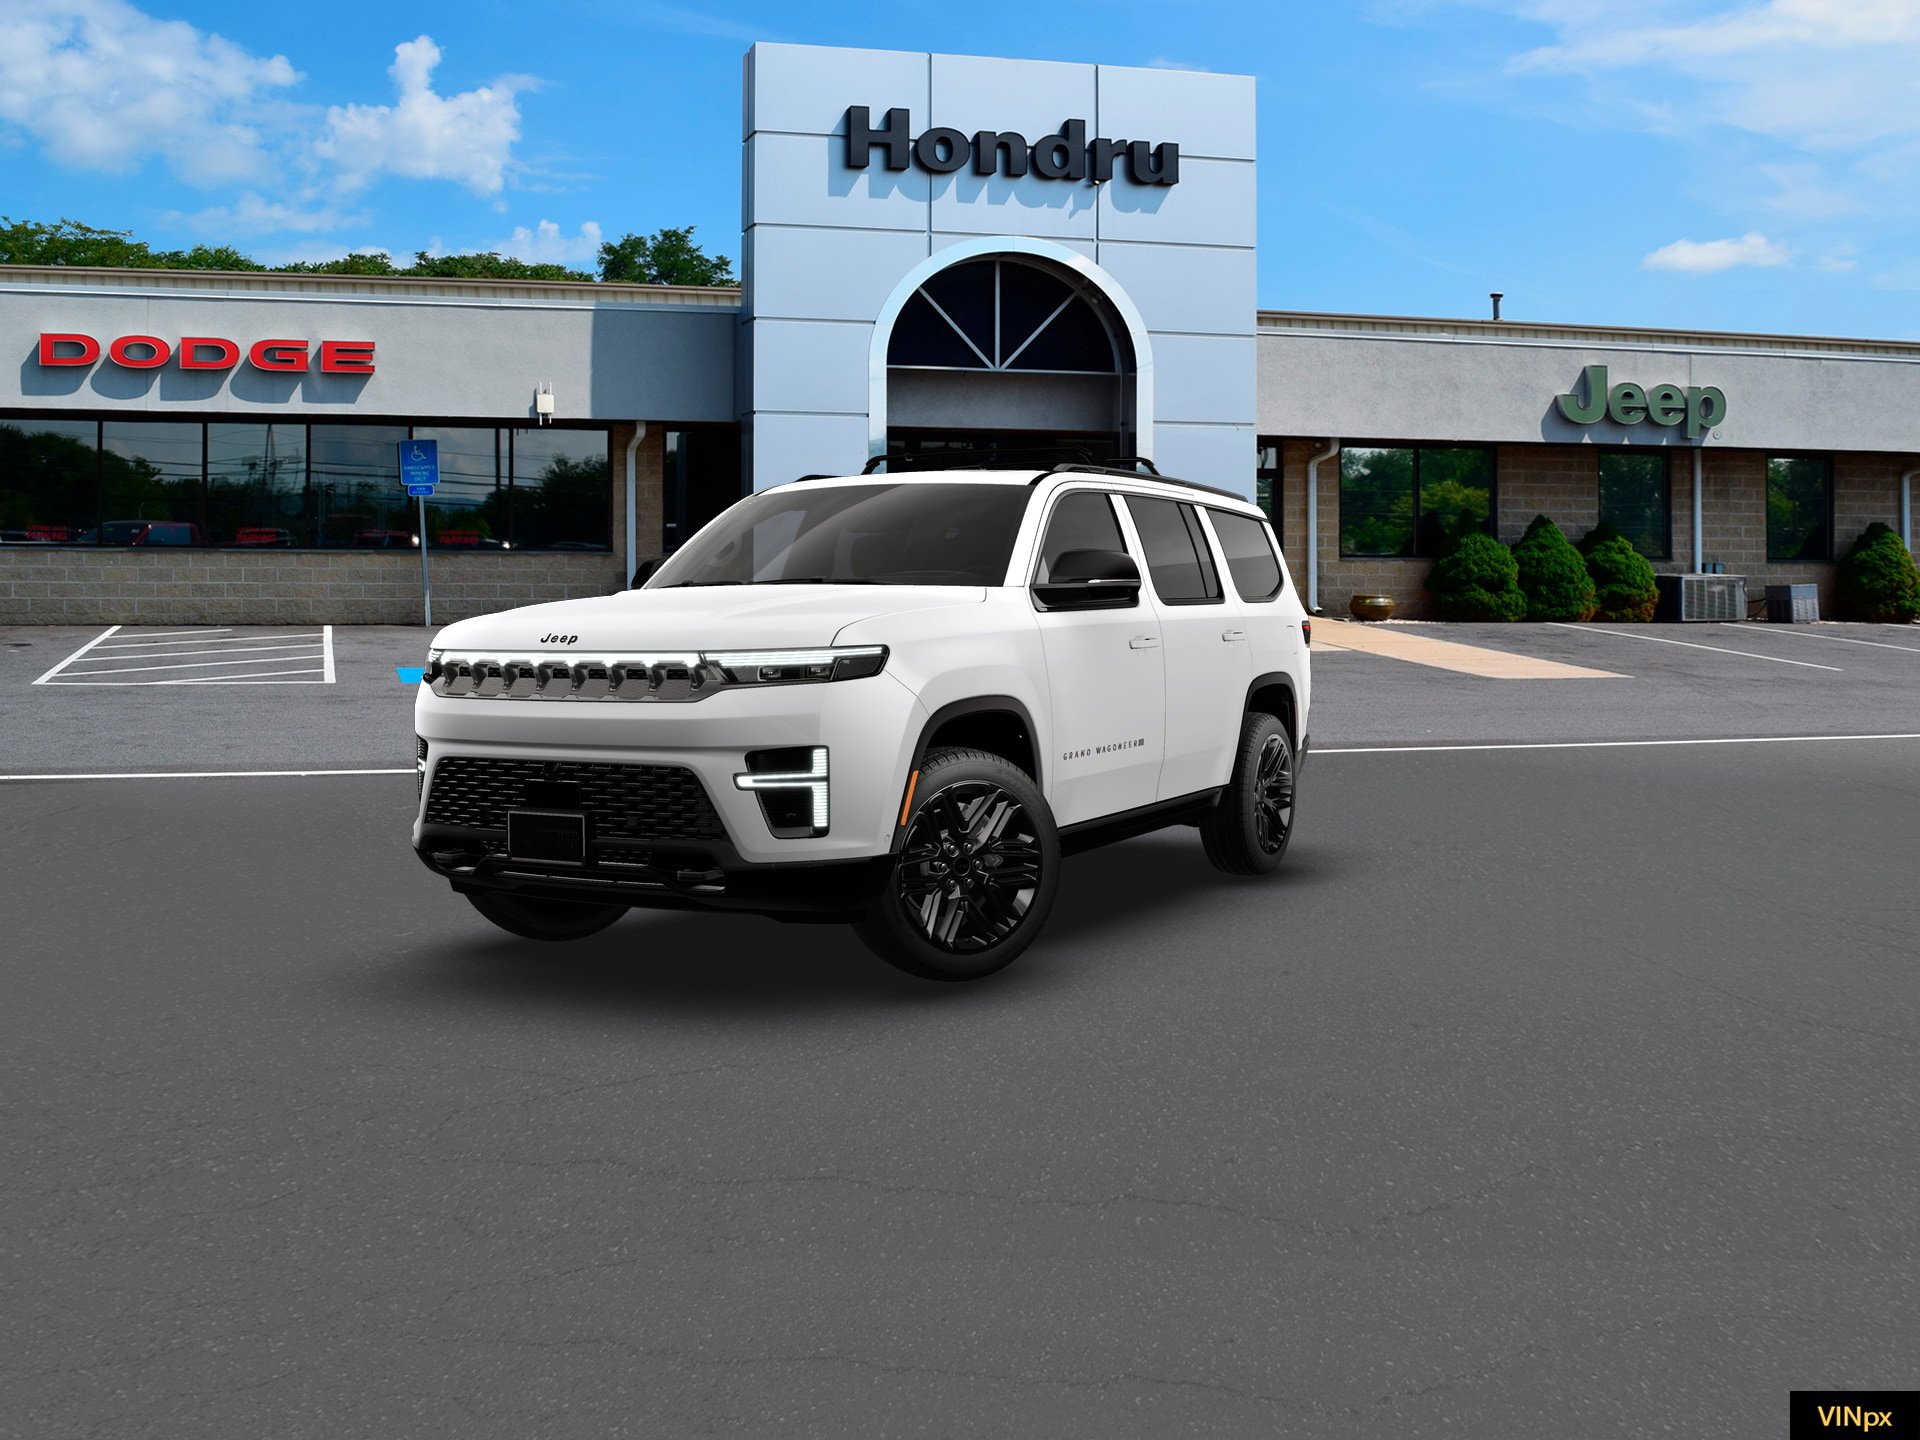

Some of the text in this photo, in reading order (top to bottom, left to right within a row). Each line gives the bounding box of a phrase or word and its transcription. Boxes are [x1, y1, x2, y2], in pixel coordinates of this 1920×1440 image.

[846, 105, 1180, 187] Hondru
[38, 333, 376, 375] DODGE
[1555, 365, 1727, 439] Jeep
[540, 633, 578, 645] Jeep
[1063, 740, 1138, 760] GRAND WAGONEER
